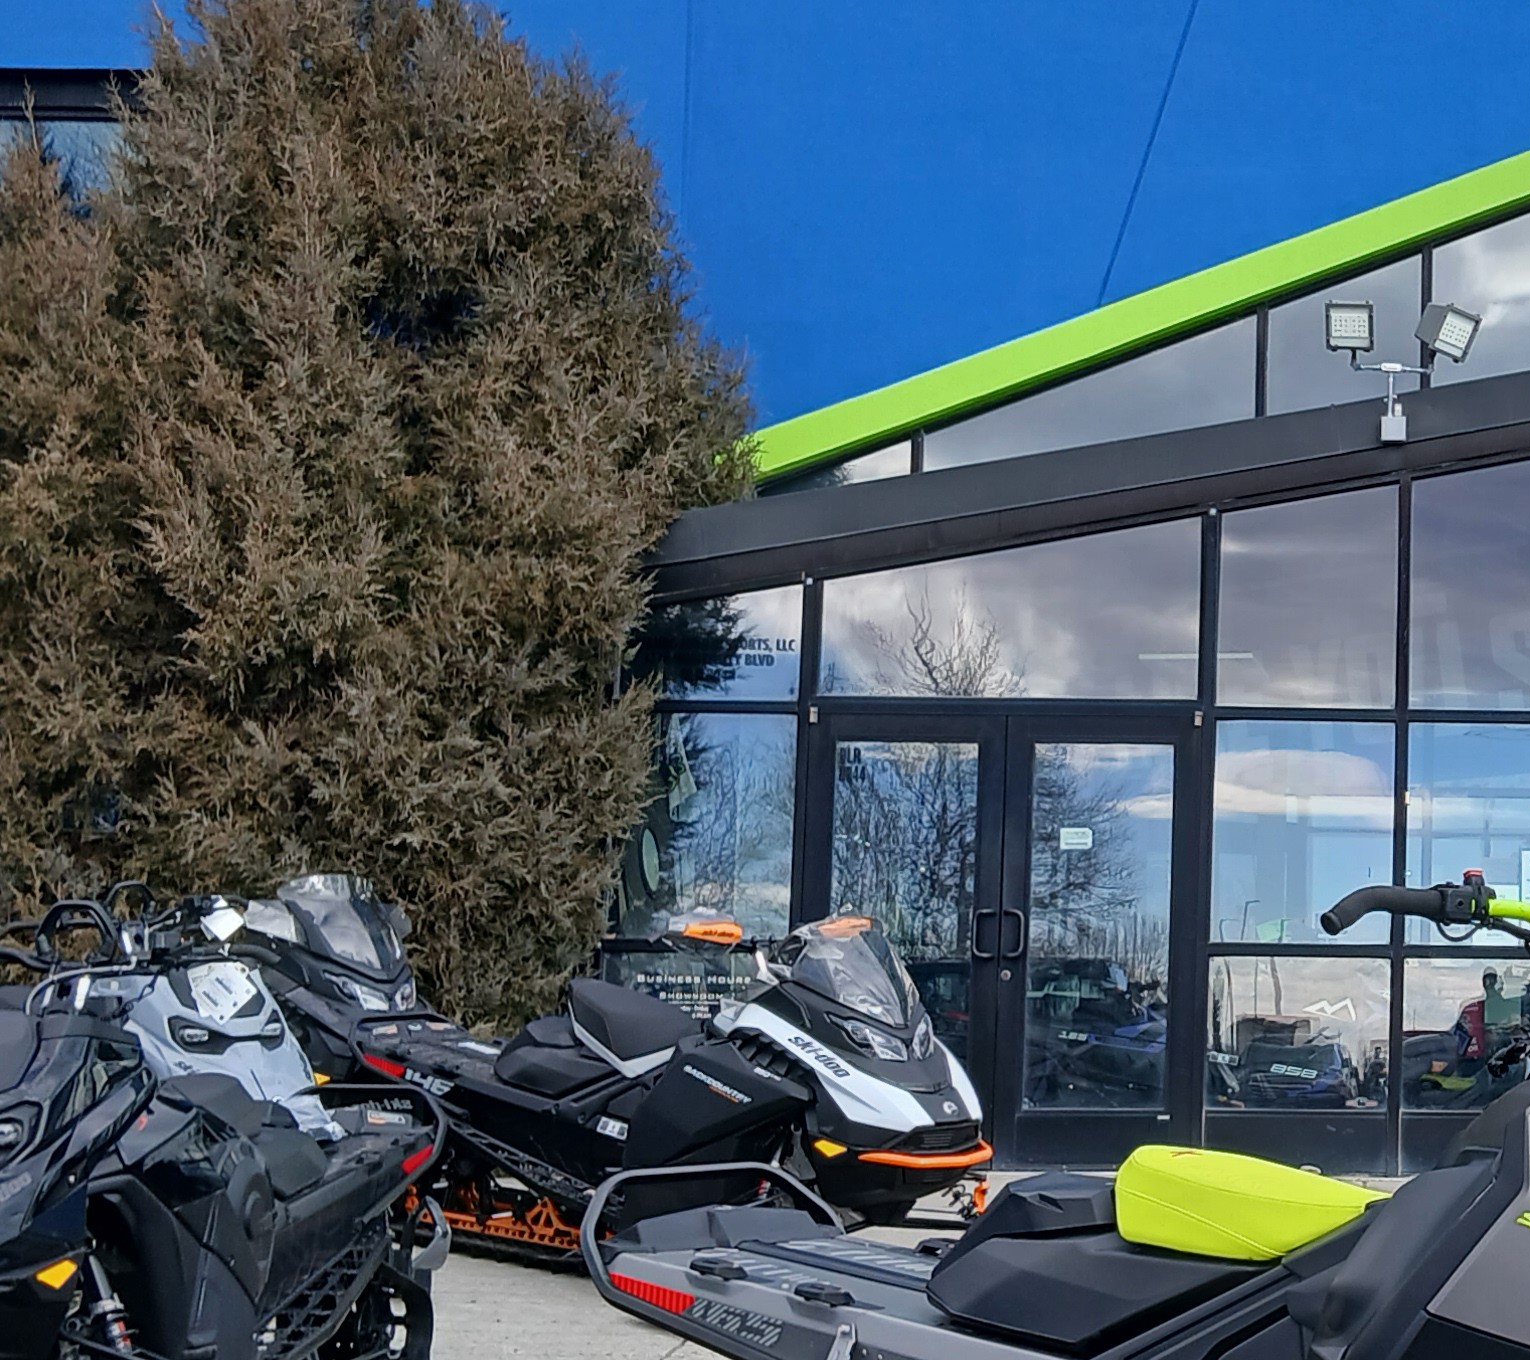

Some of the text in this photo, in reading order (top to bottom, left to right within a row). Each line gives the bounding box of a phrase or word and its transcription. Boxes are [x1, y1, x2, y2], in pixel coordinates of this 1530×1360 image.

[776, 638, 796, 652] LLC
[744, 654, 775, 667] BLVD
[787, 1036, 850, 1078] ski-doo
[1270, 1063, 1318, 1079] 858
[405, 1067, 455, 1096] 146
